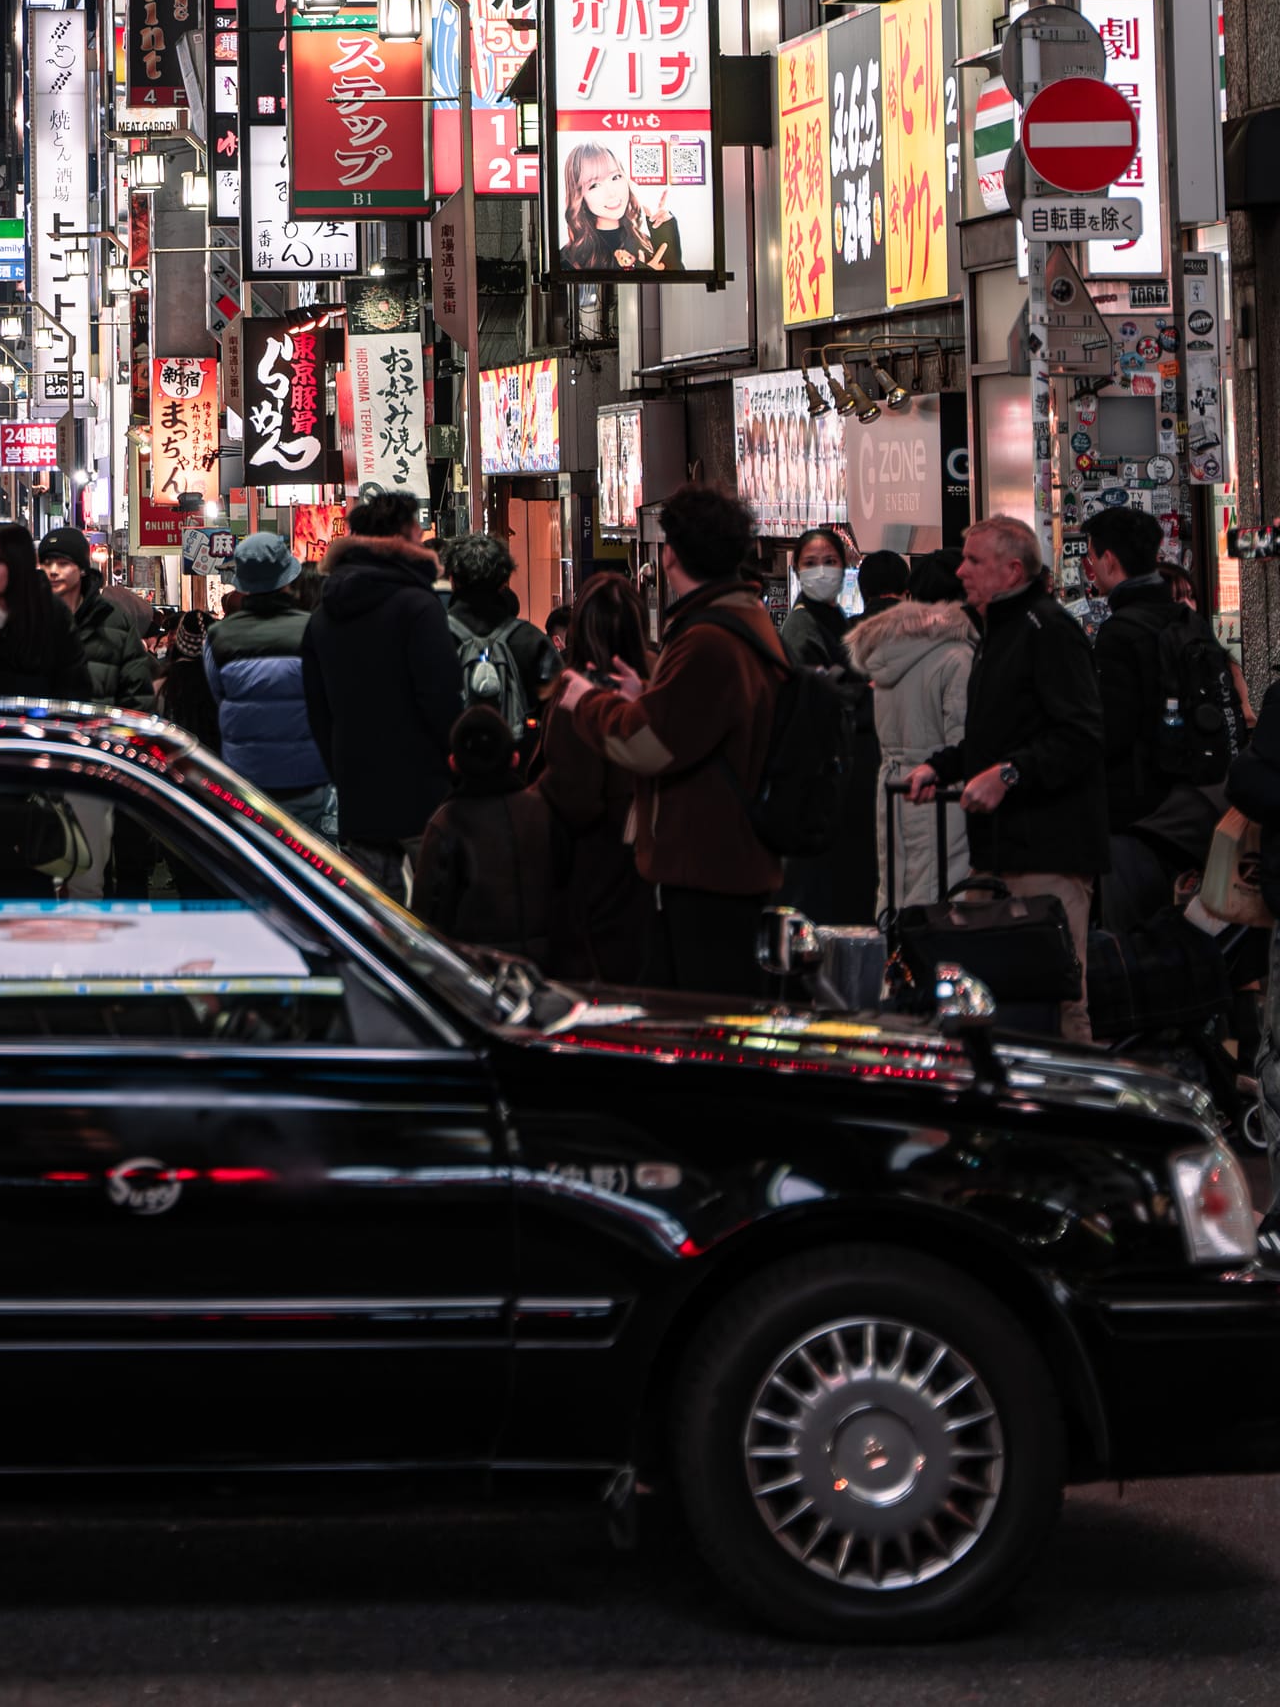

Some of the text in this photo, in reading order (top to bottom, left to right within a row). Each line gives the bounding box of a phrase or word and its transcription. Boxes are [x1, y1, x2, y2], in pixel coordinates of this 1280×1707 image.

[329, 36, 393, 187] ステップ
[602, 113, 661, 128] くりぃむ
[352, 193, 372, 205] B1
[1031, 205, 1134, 233] 自転車を除く
[320, 253, 355, 268] B1F
[441, 224, 456, 314] 劇場通り一番街
[291, 333, 318, 435] 東京豚骨
[356, 348, 370, 403] HIROSHIMA
[377, 346, 424, 484] お好み焼き
[5, 427, 57, 445] 24時間
[5, 447, 57, 464] 営業中
[885, 493, 921, 512] ENERGY
